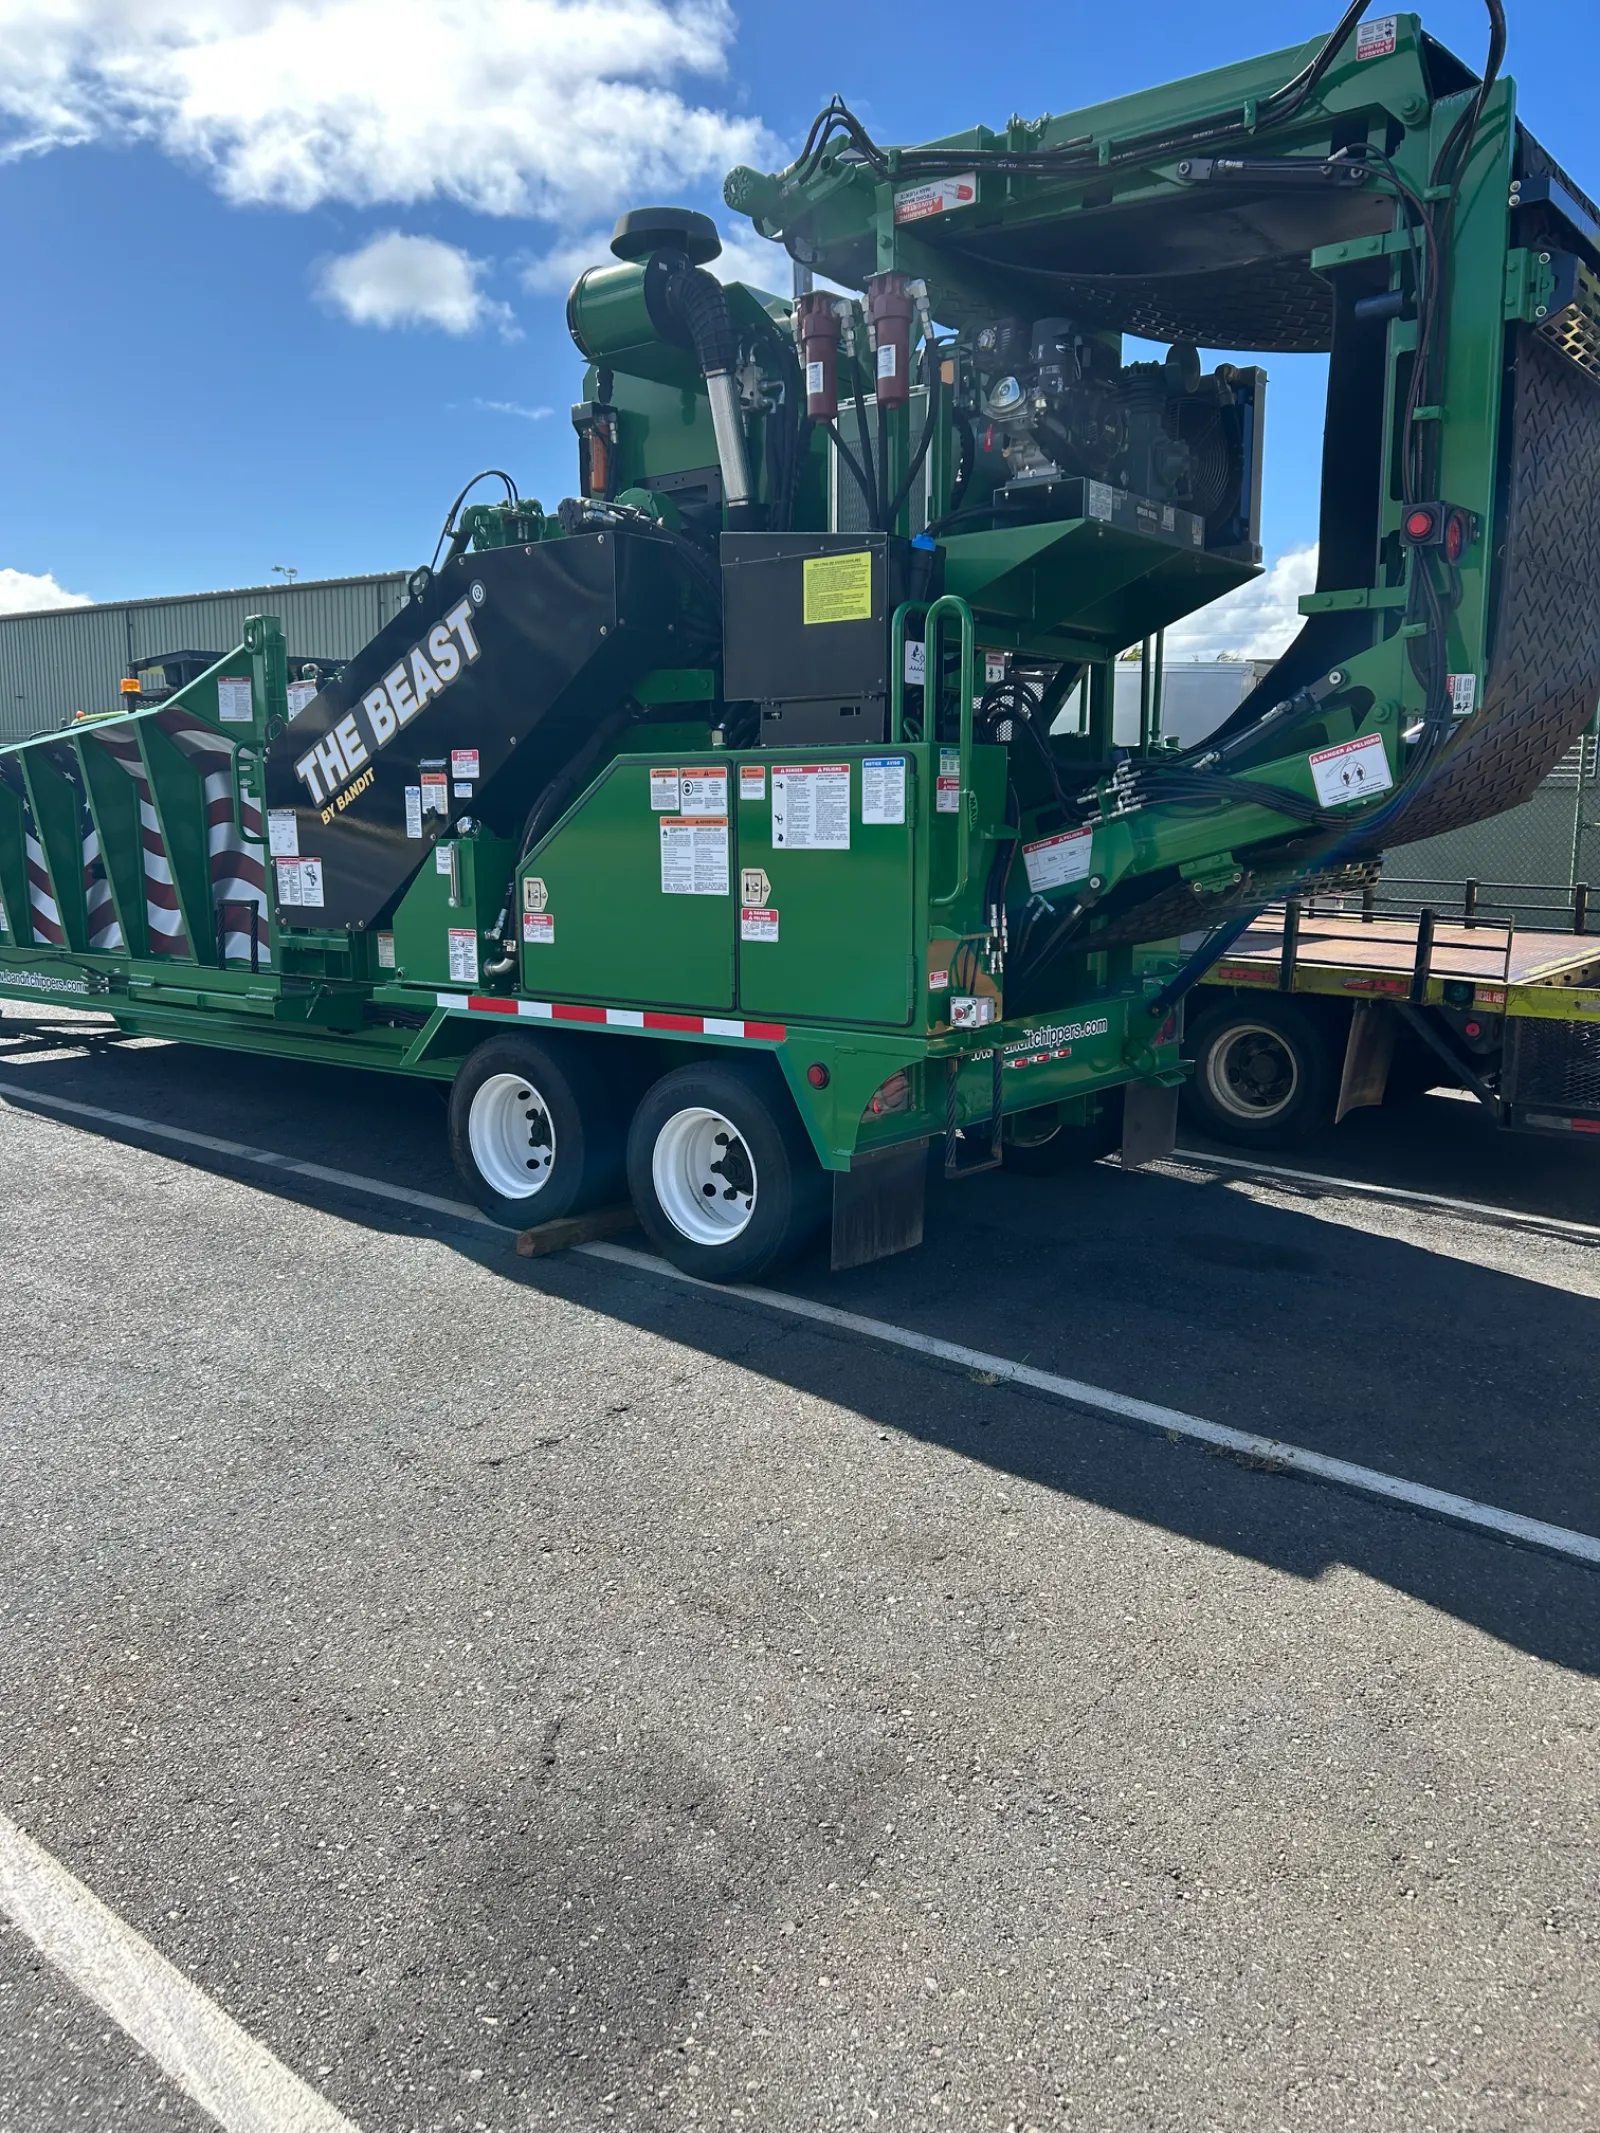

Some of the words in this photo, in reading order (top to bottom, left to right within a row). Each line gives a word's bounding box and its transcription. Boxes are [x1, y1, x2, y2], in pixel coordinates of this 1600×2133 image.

[296, 713, 368, 804] THE
[362, 599, 478, 746] BEAST
[1319, 749, 1345, 760] DANGER
[1352, 737, 1380, 750] PELIGRO
[321, 803, 335, 825] BY
[336, 767, 375, 811] BANDIT
